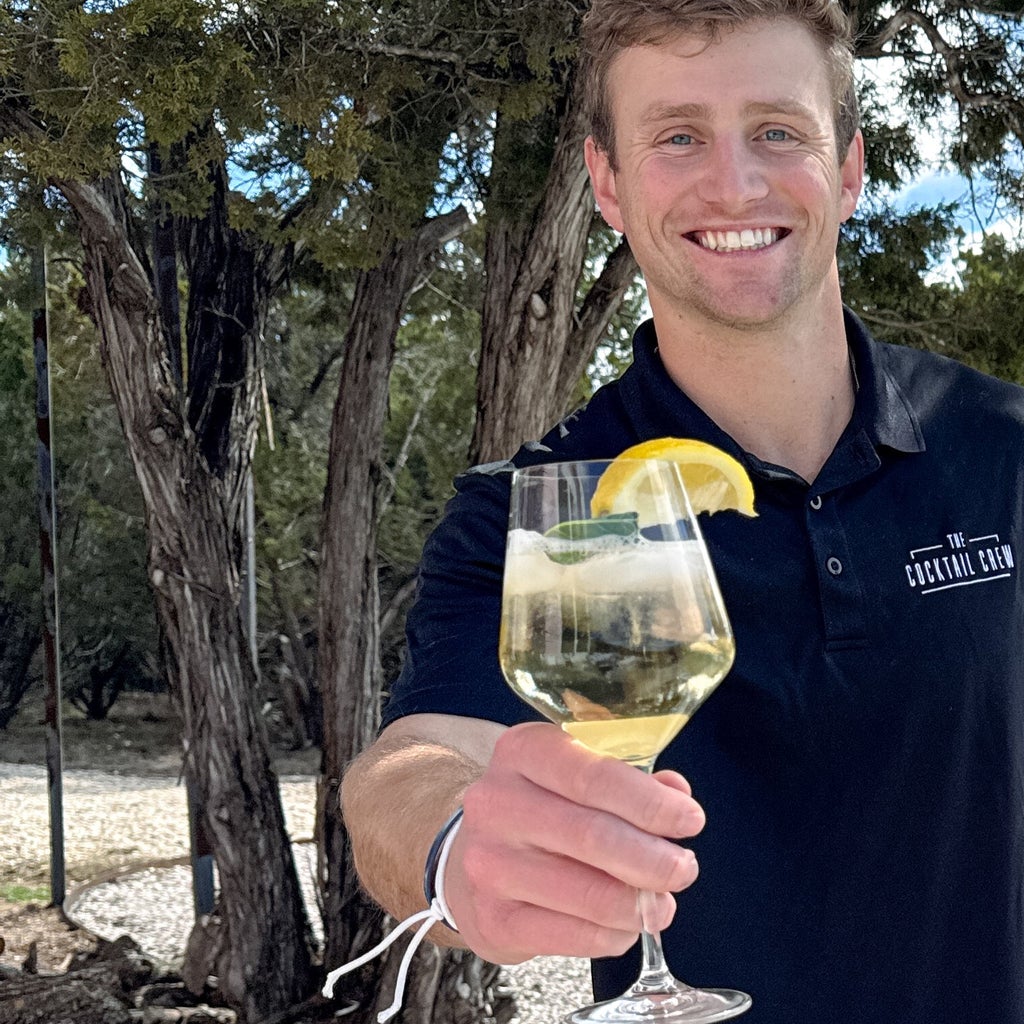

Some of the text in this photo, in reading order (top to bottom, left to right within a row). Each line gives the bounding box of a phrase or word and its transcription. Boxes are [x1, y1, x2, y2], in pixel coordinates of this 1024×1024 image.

[946, 532, 966, 549] THE
[905, 544, 1015, 587] COCKTAIL CREW
